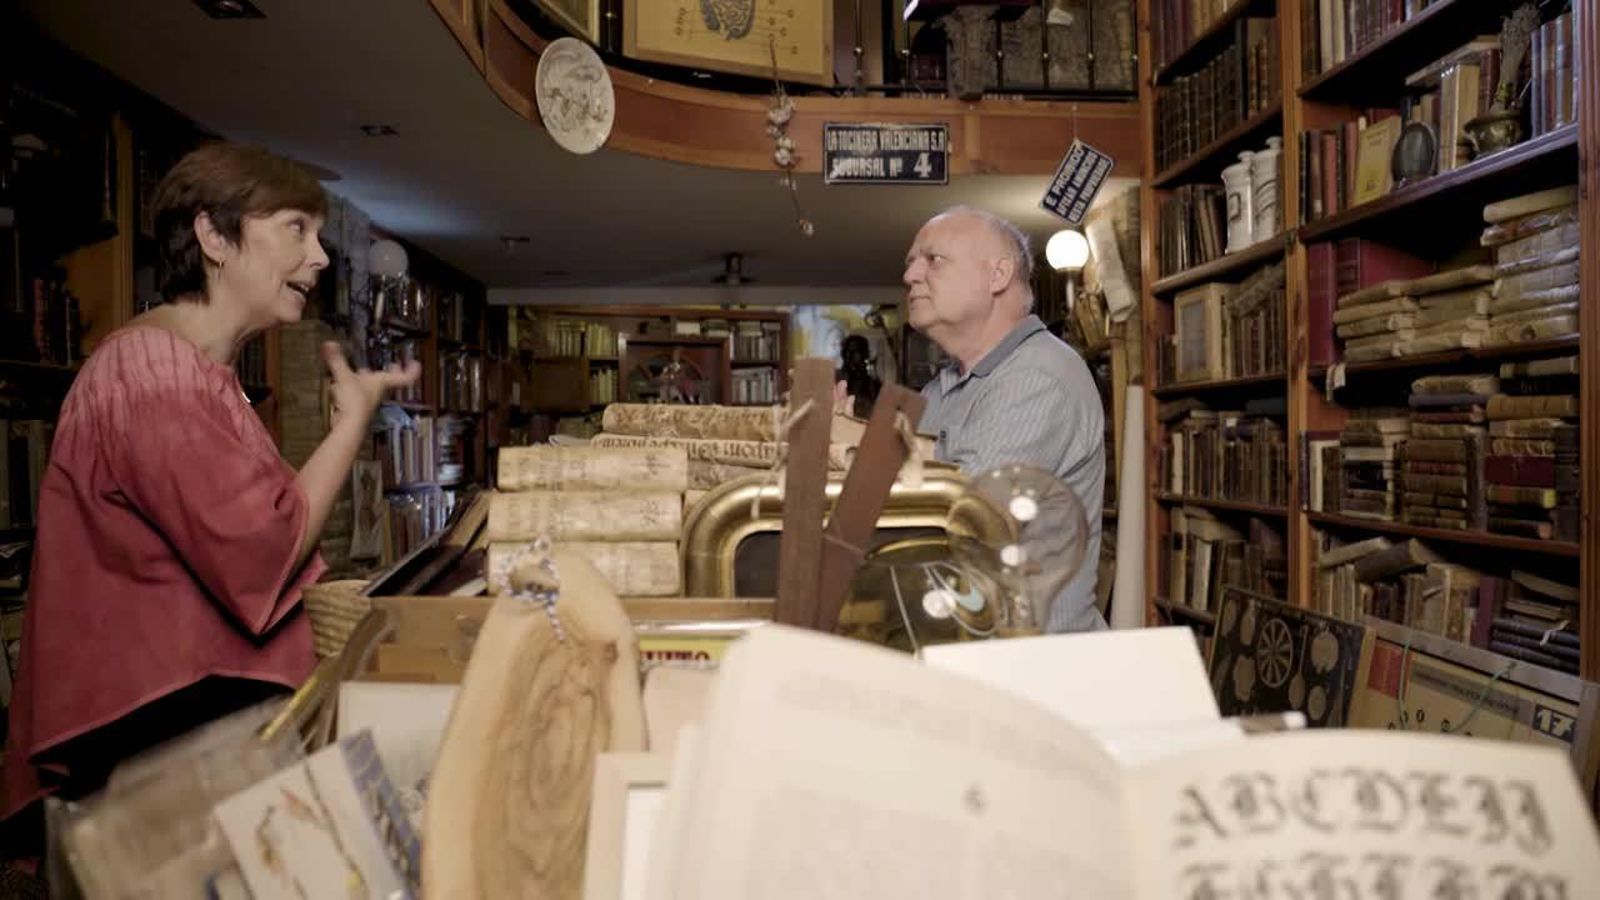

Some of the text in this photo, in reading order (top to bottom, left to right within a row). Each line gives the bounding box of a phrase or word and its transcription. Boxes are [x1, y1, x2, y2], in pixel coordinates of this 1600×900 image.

[879, 130, 930, 151] VALENCIANA
[831, 157, 885, 178] SUCURSAL
[913, 152, 932, 178] 4
[1537, 708, 1575, 737] 17
